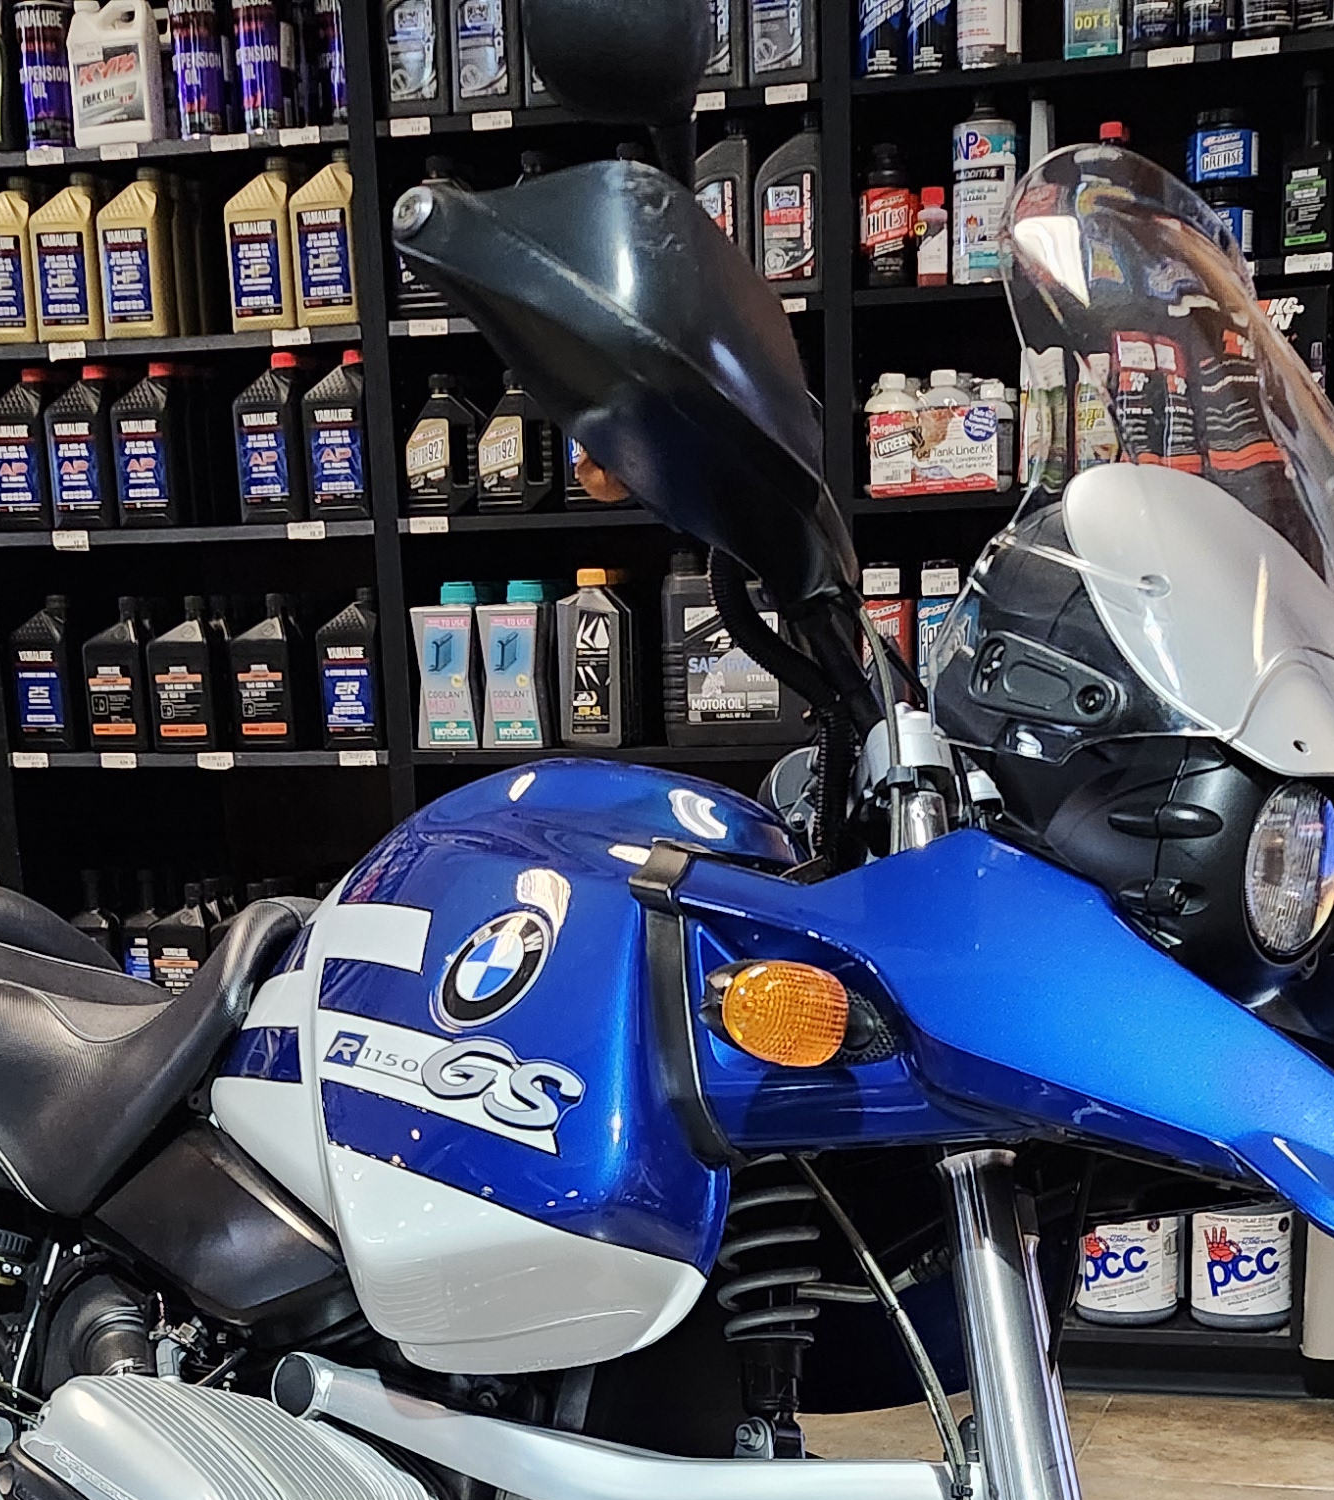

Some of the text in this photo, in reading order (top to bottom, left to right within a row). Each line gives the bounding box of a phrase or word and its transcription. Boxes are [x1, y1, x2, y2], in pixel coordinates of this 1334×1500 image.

[1075, 12, 1100, 30] DOT
[32, 82, 48, 99] OIL
[83, 87, 115, 108] FORK OIL
[1201, 149, 1244, 170] GREASE
[301, 210, 341, 225] YAMALUBE
[233, 221, 272, 236] YAMALUBE
[41, 233, 78, 247] YAMALUBE
[105, 230, 143, 244] YAMALUBE
[242, 411, 278, 426] YAMALUBE
[314, 408, 353, 423] YAMALUBE
[54, 422, 89, 436] YAMALUBE
[120, 419, 157, 434] YAMALUBE
[871, 424, 905, 436] Original
[428, 439, 445, 461] 927
[501, 437, 517, 459] 927
[933, 444, 994, 457] Tank Liner Kit
[441, 618, 466, 627] TO USE
[507, 618, 530, 627] TO USE
[18, 651, 53, 663] YAMALUBE
[327, 646, 364, 660] YAMALUBE
[688, 657, 718, 673] SAE
[428, 691, 464, 699] COOLANT
[493, 690, 529, 699] COOLANT
[692, 698, 745, 711] MOTOR OIL
[434, 728, 469, 737] MOTOREX
[499, 728, 535, 737] MOTOREX
[363, 1046, 419, 1073] 1150
[423, 1039, 585, 1130] GS
[1084, 1246, 1148, 1291] pcc
[1207, 1247, 1280, 1297] pcc
